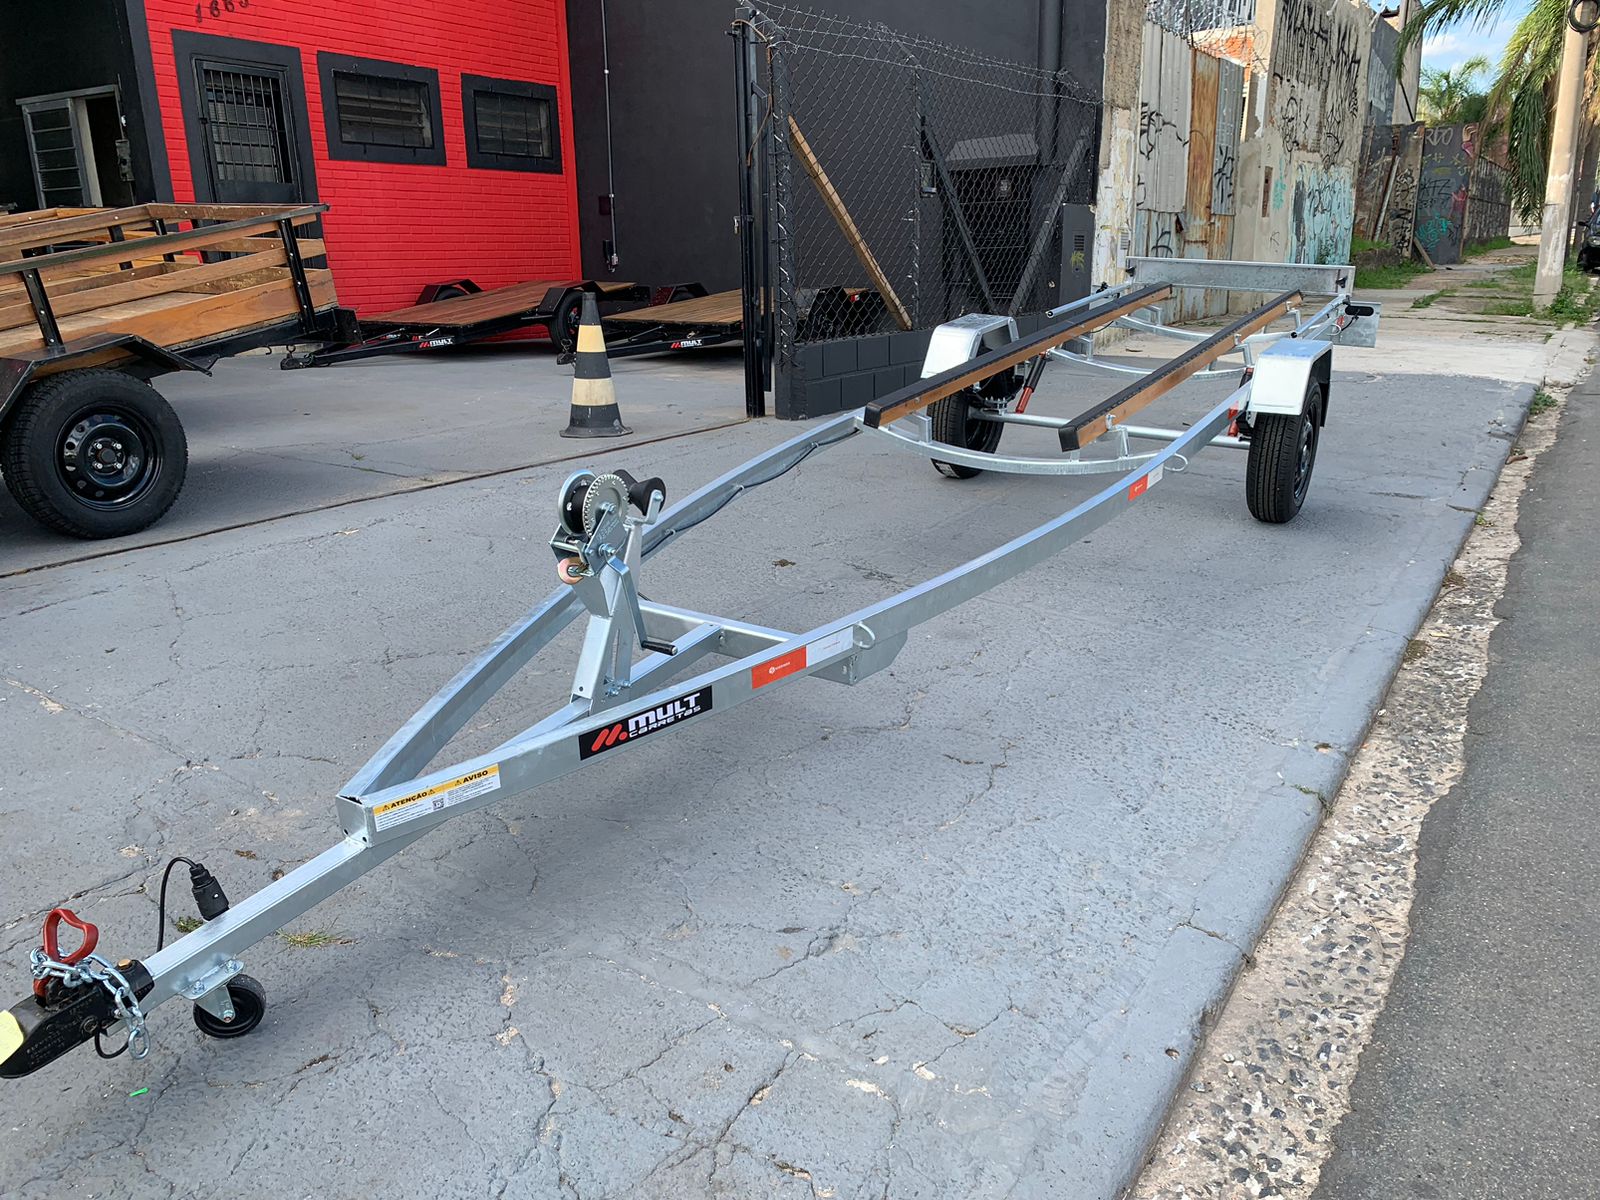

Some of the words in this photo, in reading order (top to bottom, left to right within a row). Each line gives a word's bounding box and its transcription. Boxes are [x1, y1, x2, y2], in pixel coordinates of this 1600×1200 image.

[628, 692, 700, 732] MULT
[629, 705, 701, 738] CARRETAS
[463, 770, 488, 784] AVISO
[390, 790, 428, 809] ATENÇÃO
